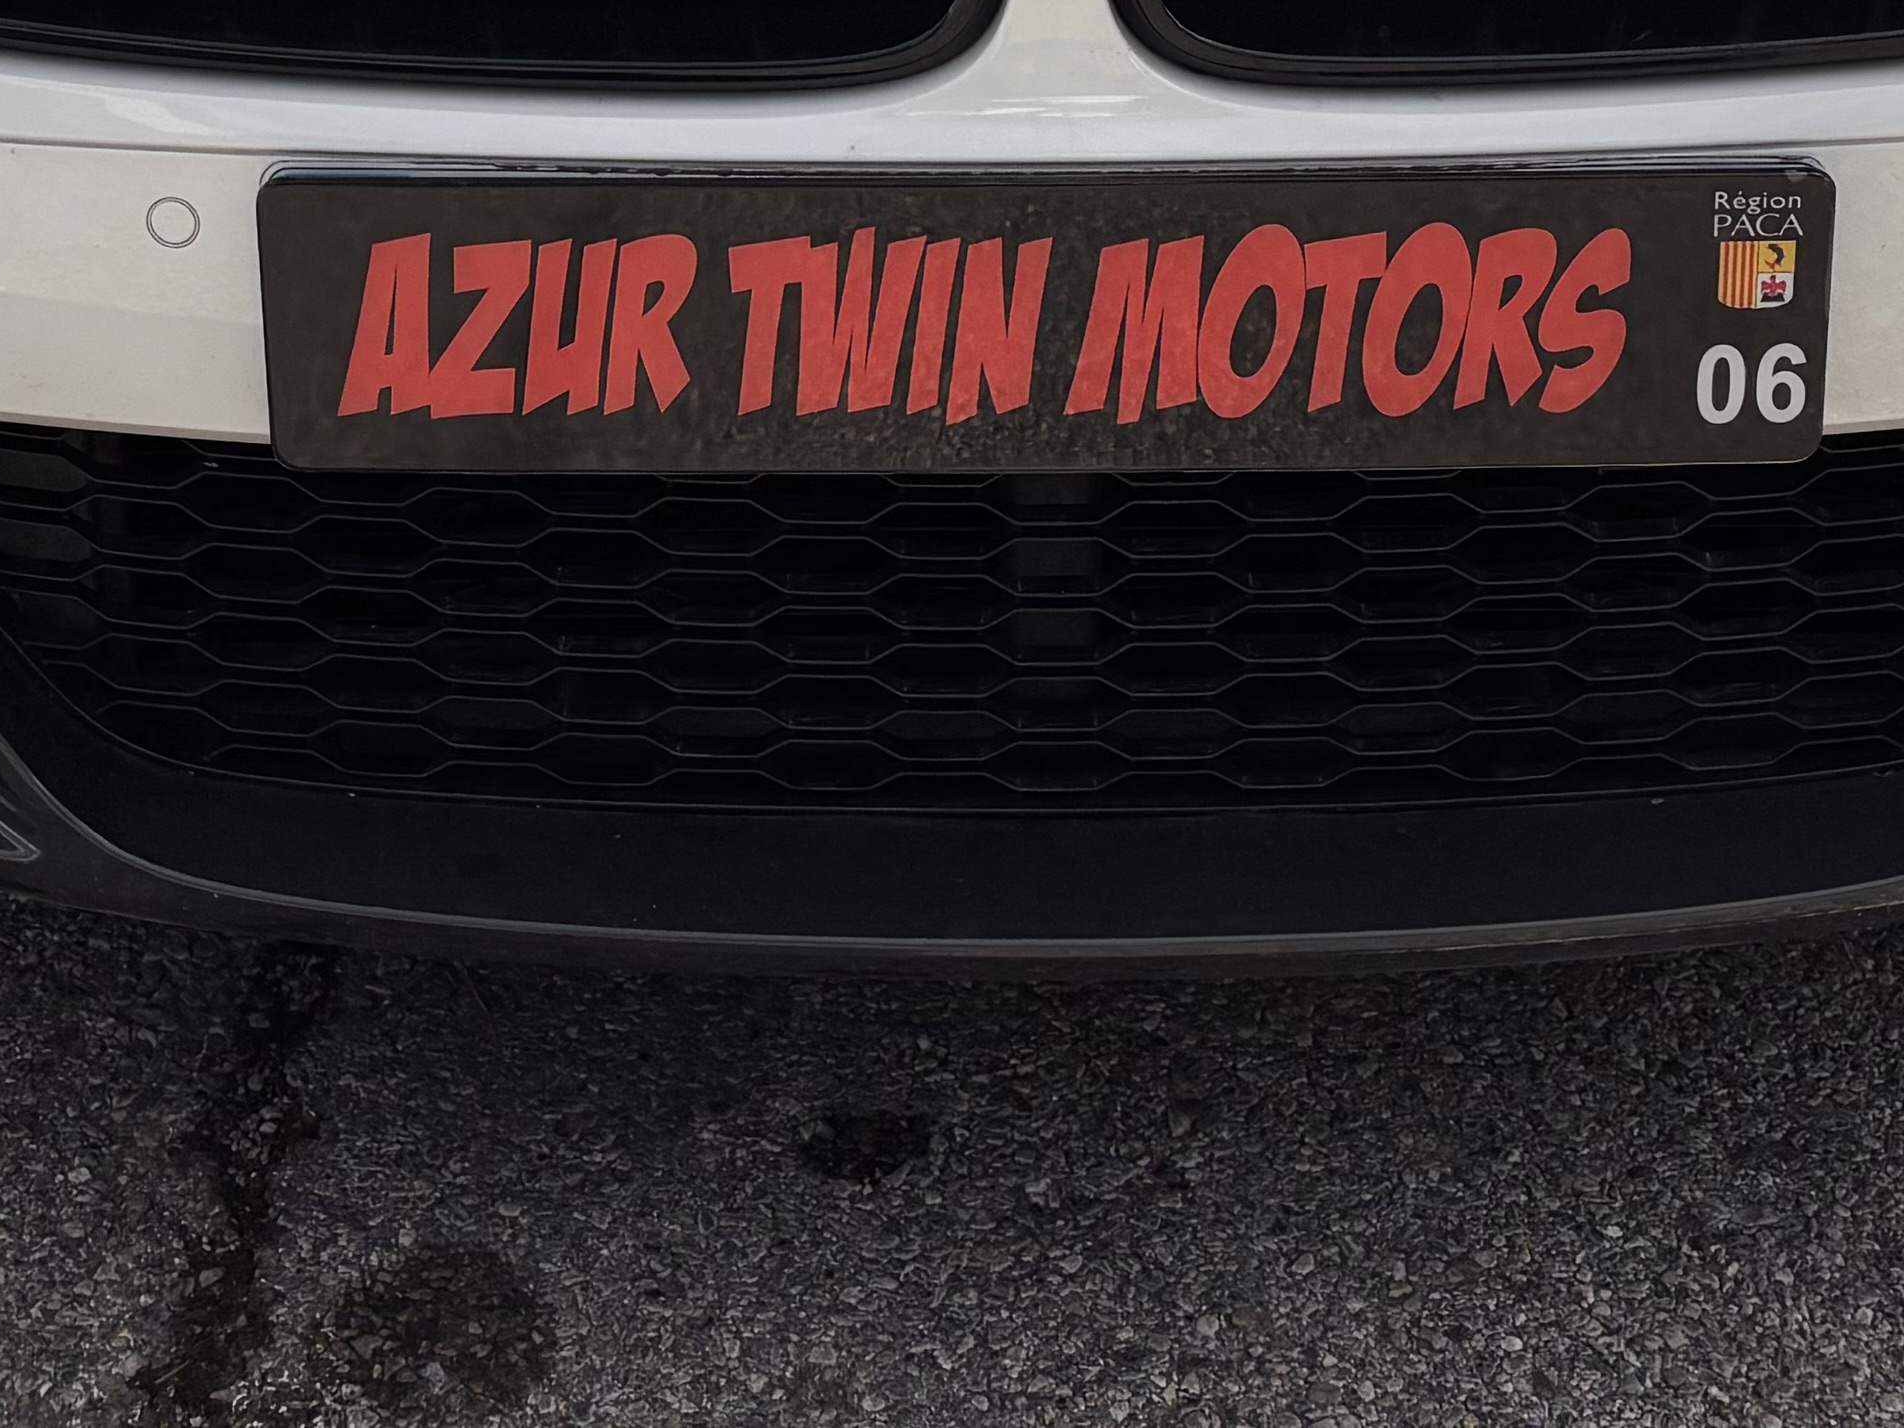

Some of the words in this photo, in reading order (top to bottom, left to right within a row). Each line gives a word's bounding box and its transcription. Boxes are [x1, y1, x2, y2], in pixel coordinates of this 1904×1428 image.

[1713, 213, 1804, 237] PACA
[1714, 191, 1802, 214] Région
[337, 232, 699, 420] AZUR
[728, 227, 1054, 426] TWIN
[1064, 222, 1632, 425] MOTORS
[1697, 342, 1807, 425] 06
